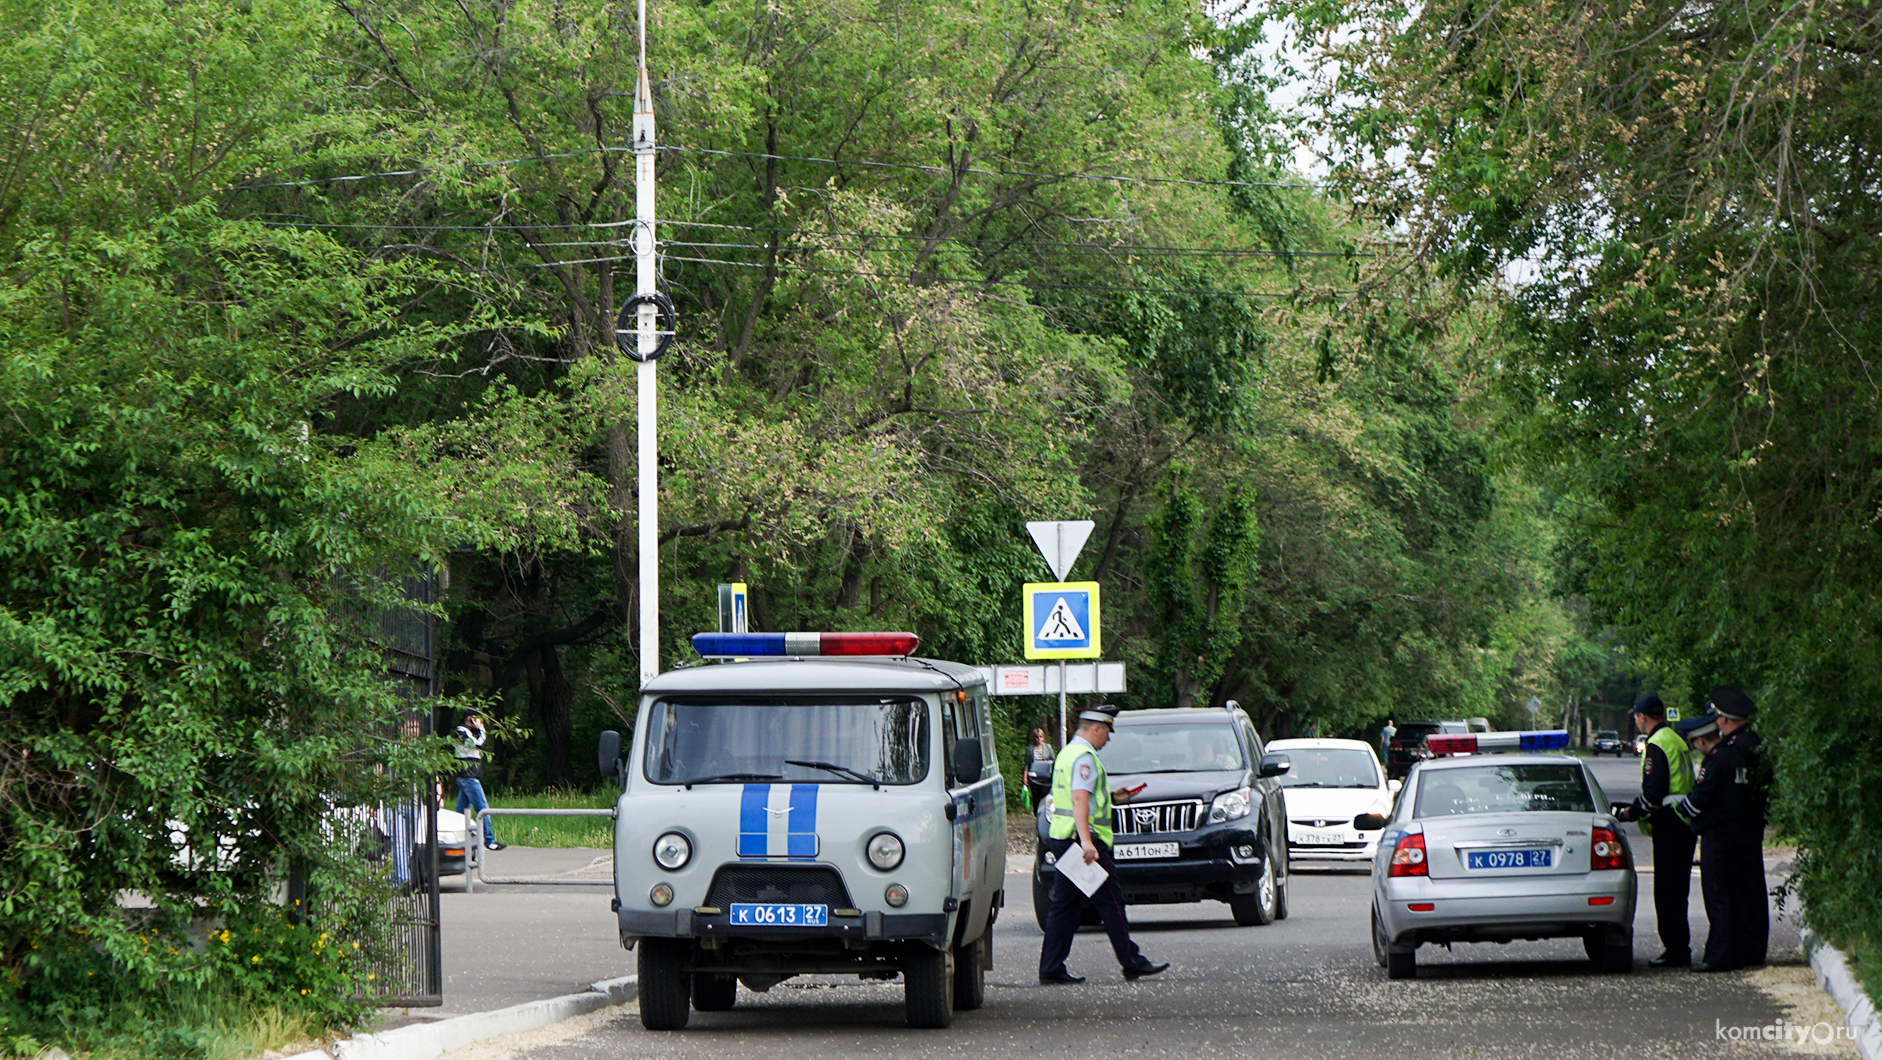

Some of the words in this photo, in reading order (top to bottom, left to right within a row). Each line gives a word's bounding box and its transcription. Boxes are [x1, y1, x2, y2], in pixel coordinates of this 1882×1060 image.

[1119, 845, 1161, 857] А611ОН
[1164, 844, 1175, 853] 27
[1488, 852, 1524, 867] 0978
[1532, 851, 1546, 862] 27
[738, 909, 749, 923] К
[755, 906, 796, 923] 0613
[805, 906, 822, 919] 27
